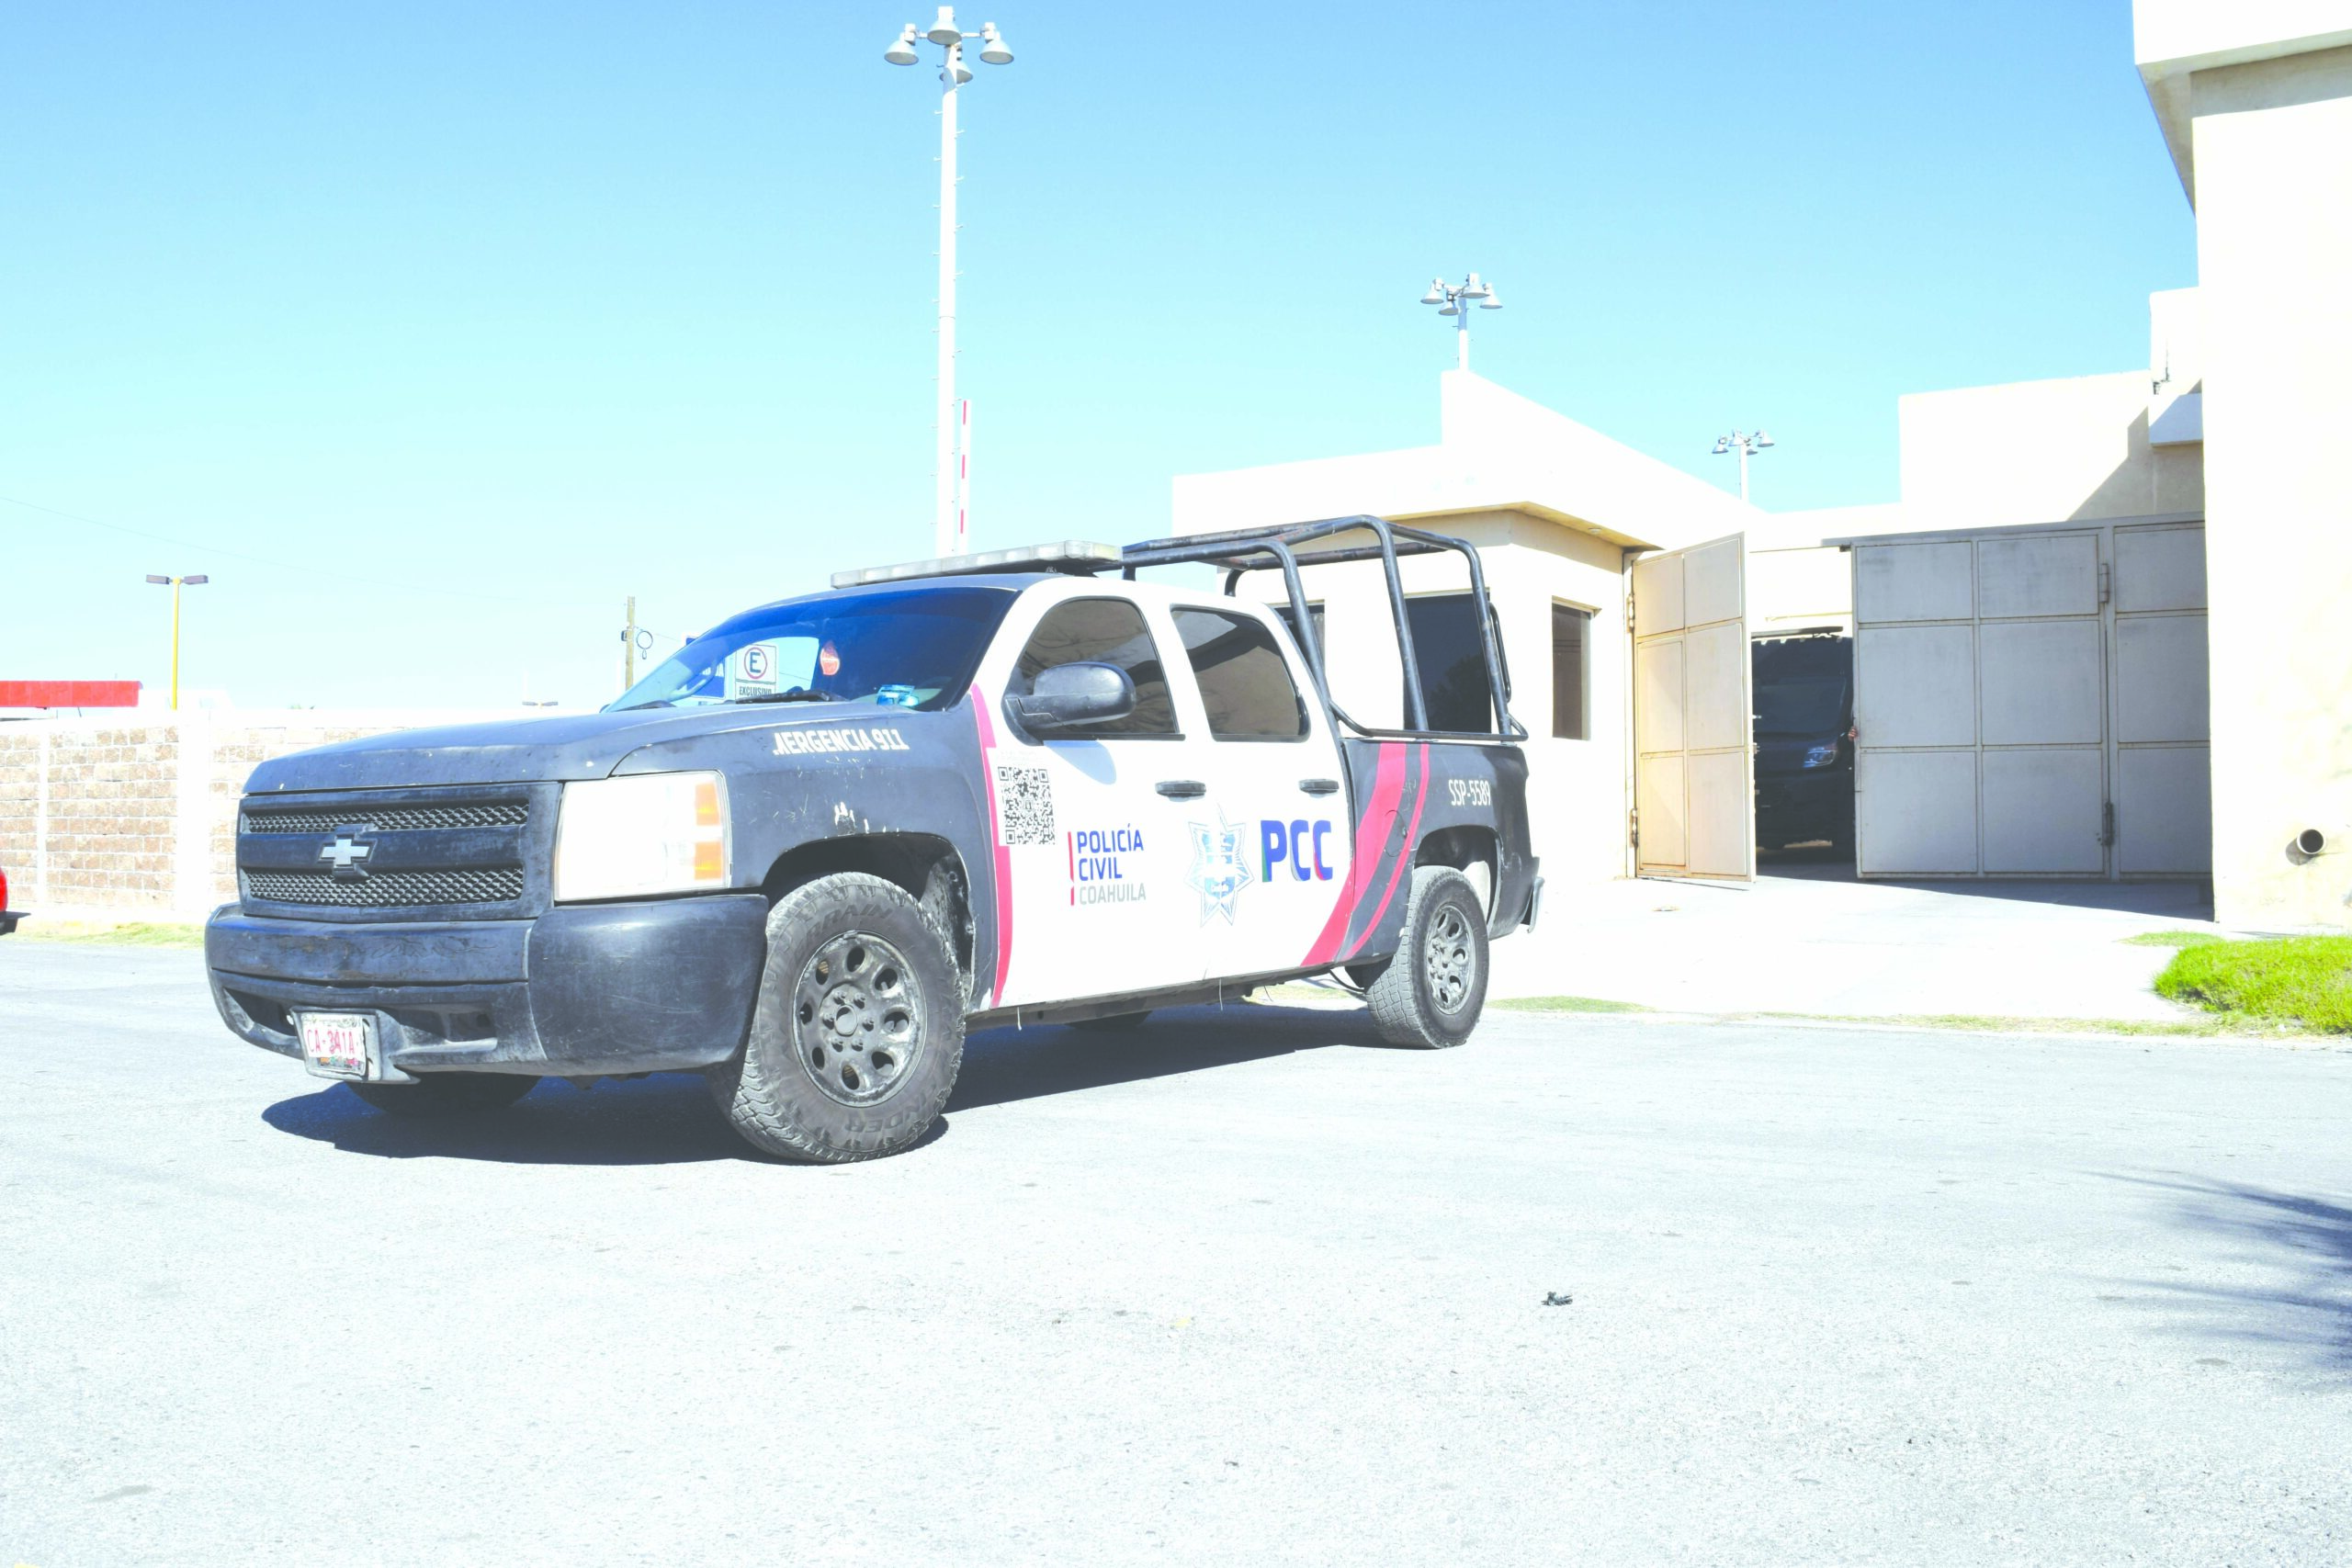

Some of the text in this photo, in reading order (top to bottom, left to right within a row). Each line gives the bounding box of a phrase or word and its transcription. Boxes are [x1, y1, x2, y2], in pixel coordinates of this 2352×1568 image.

[750, 651, 762, 673] E
[871, 728, 910, 750] 911
[1448, 779, 1491, 807] SSP-5589
[1077, 823, 1144, 853] POLICÍA
[1260, 819, 1334, 883] PCC
[1078, 856, 1123, 882] CIVIL
[1079, 883, 1147, 906] COAHUILA
